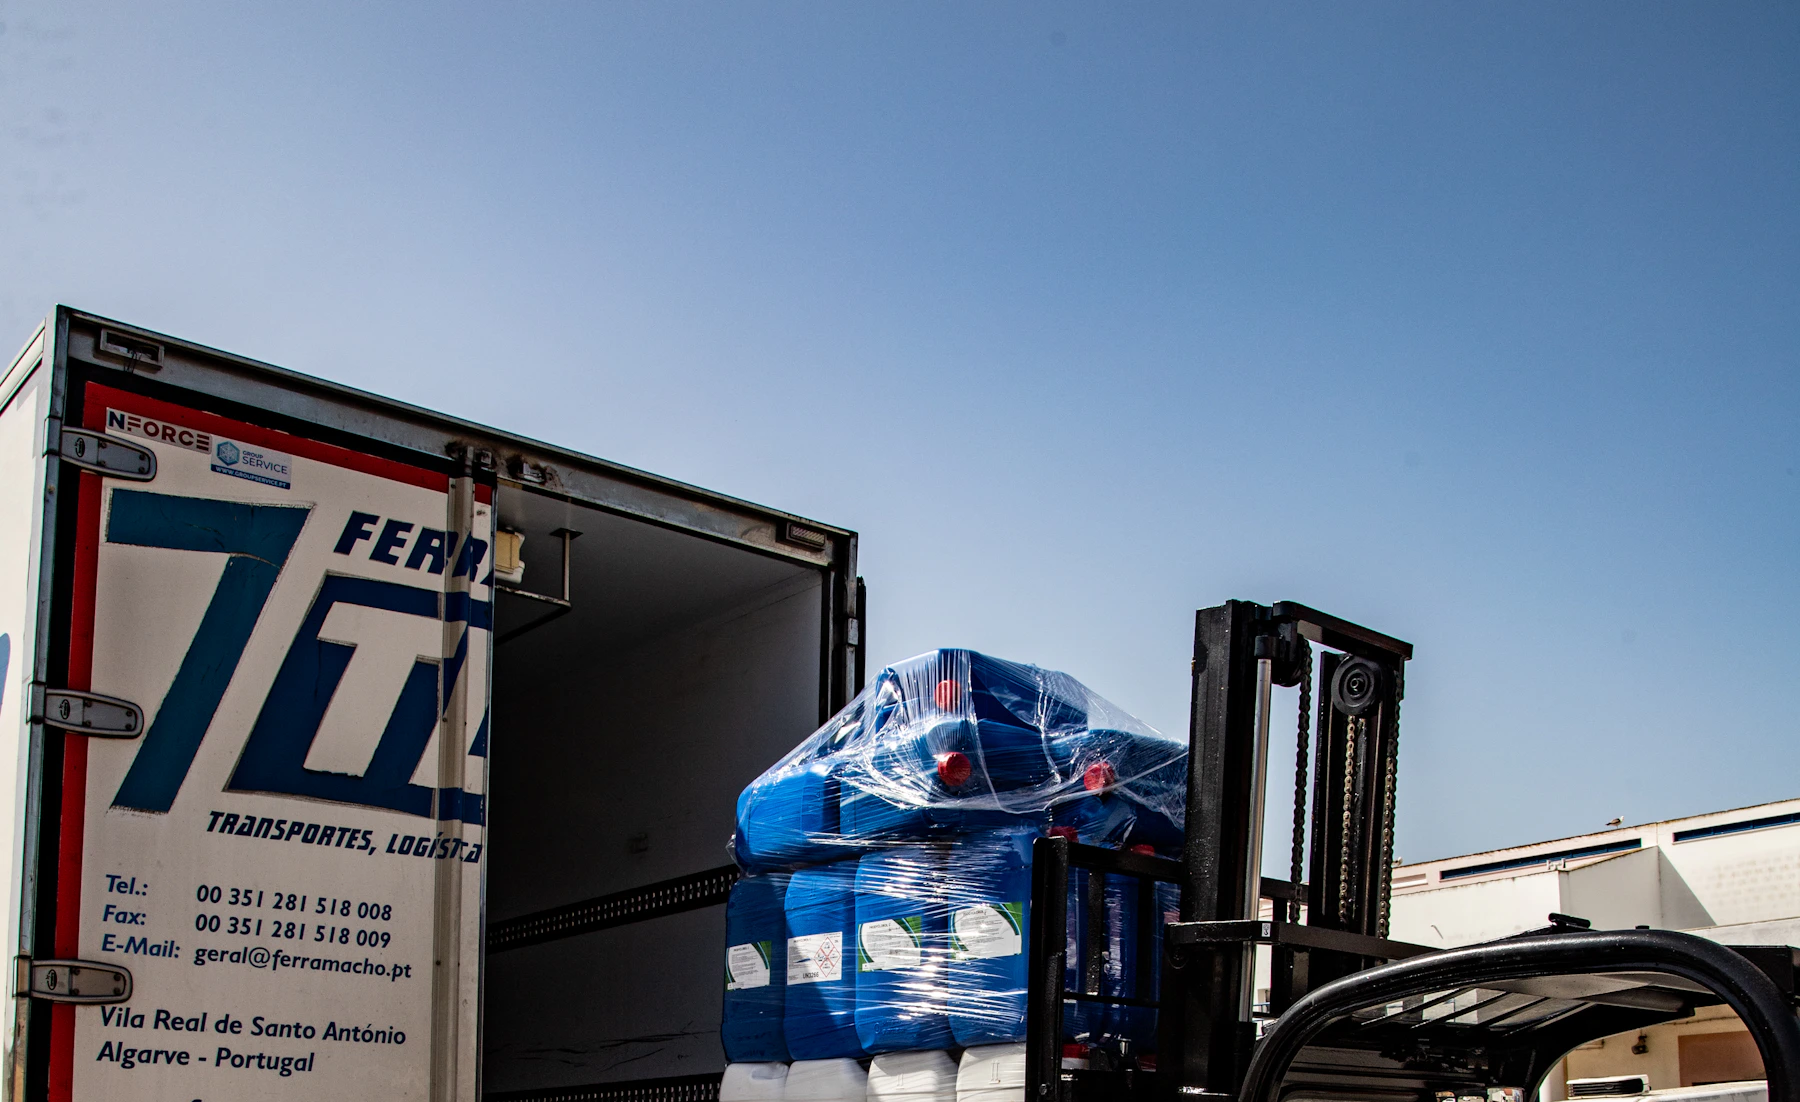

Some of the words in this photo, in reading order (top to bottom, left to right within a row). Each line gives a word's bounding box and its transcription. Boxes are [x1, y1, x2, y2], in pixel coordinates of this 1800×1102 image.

[108, 411, 210, 452] NFORCE
[242, 456, 288, 475] SERVICE
[206, 810, 376, 856] TRANSPORTES,
[105, 874, 148, 896] Tel.:
[196, 884, 222, 904] 00
[228, 888, 264, 908] 351
[272, 892, 307, 912] 281
[315, 897, 352, 917] 518
[357, 902, 392, 921] 008
[102, 904, 147, 926] Fax:
[195, 913, 221, 933] 00
[227, 916, 262, 936] 351
[271, 920, 306, 940] 281
[314, 925, 350, 945] 518
[356, 929, 391, 949] 009
[101, 933, 180, 959] E-Mail:
[193, 945, 412, 982] geral@ferramacho.pt
[100, 1005, 145, 1029] Vila
[153, 1008, 208, 1033] Real
[214, 1013, 243, 1035] de
[250, 1015, 316, 1039] Santo
[321, 1020, 407, 1045] António
[96, 1040, 190, 1070] Algarve
[215, 1046, 315, 1077] Portugal
